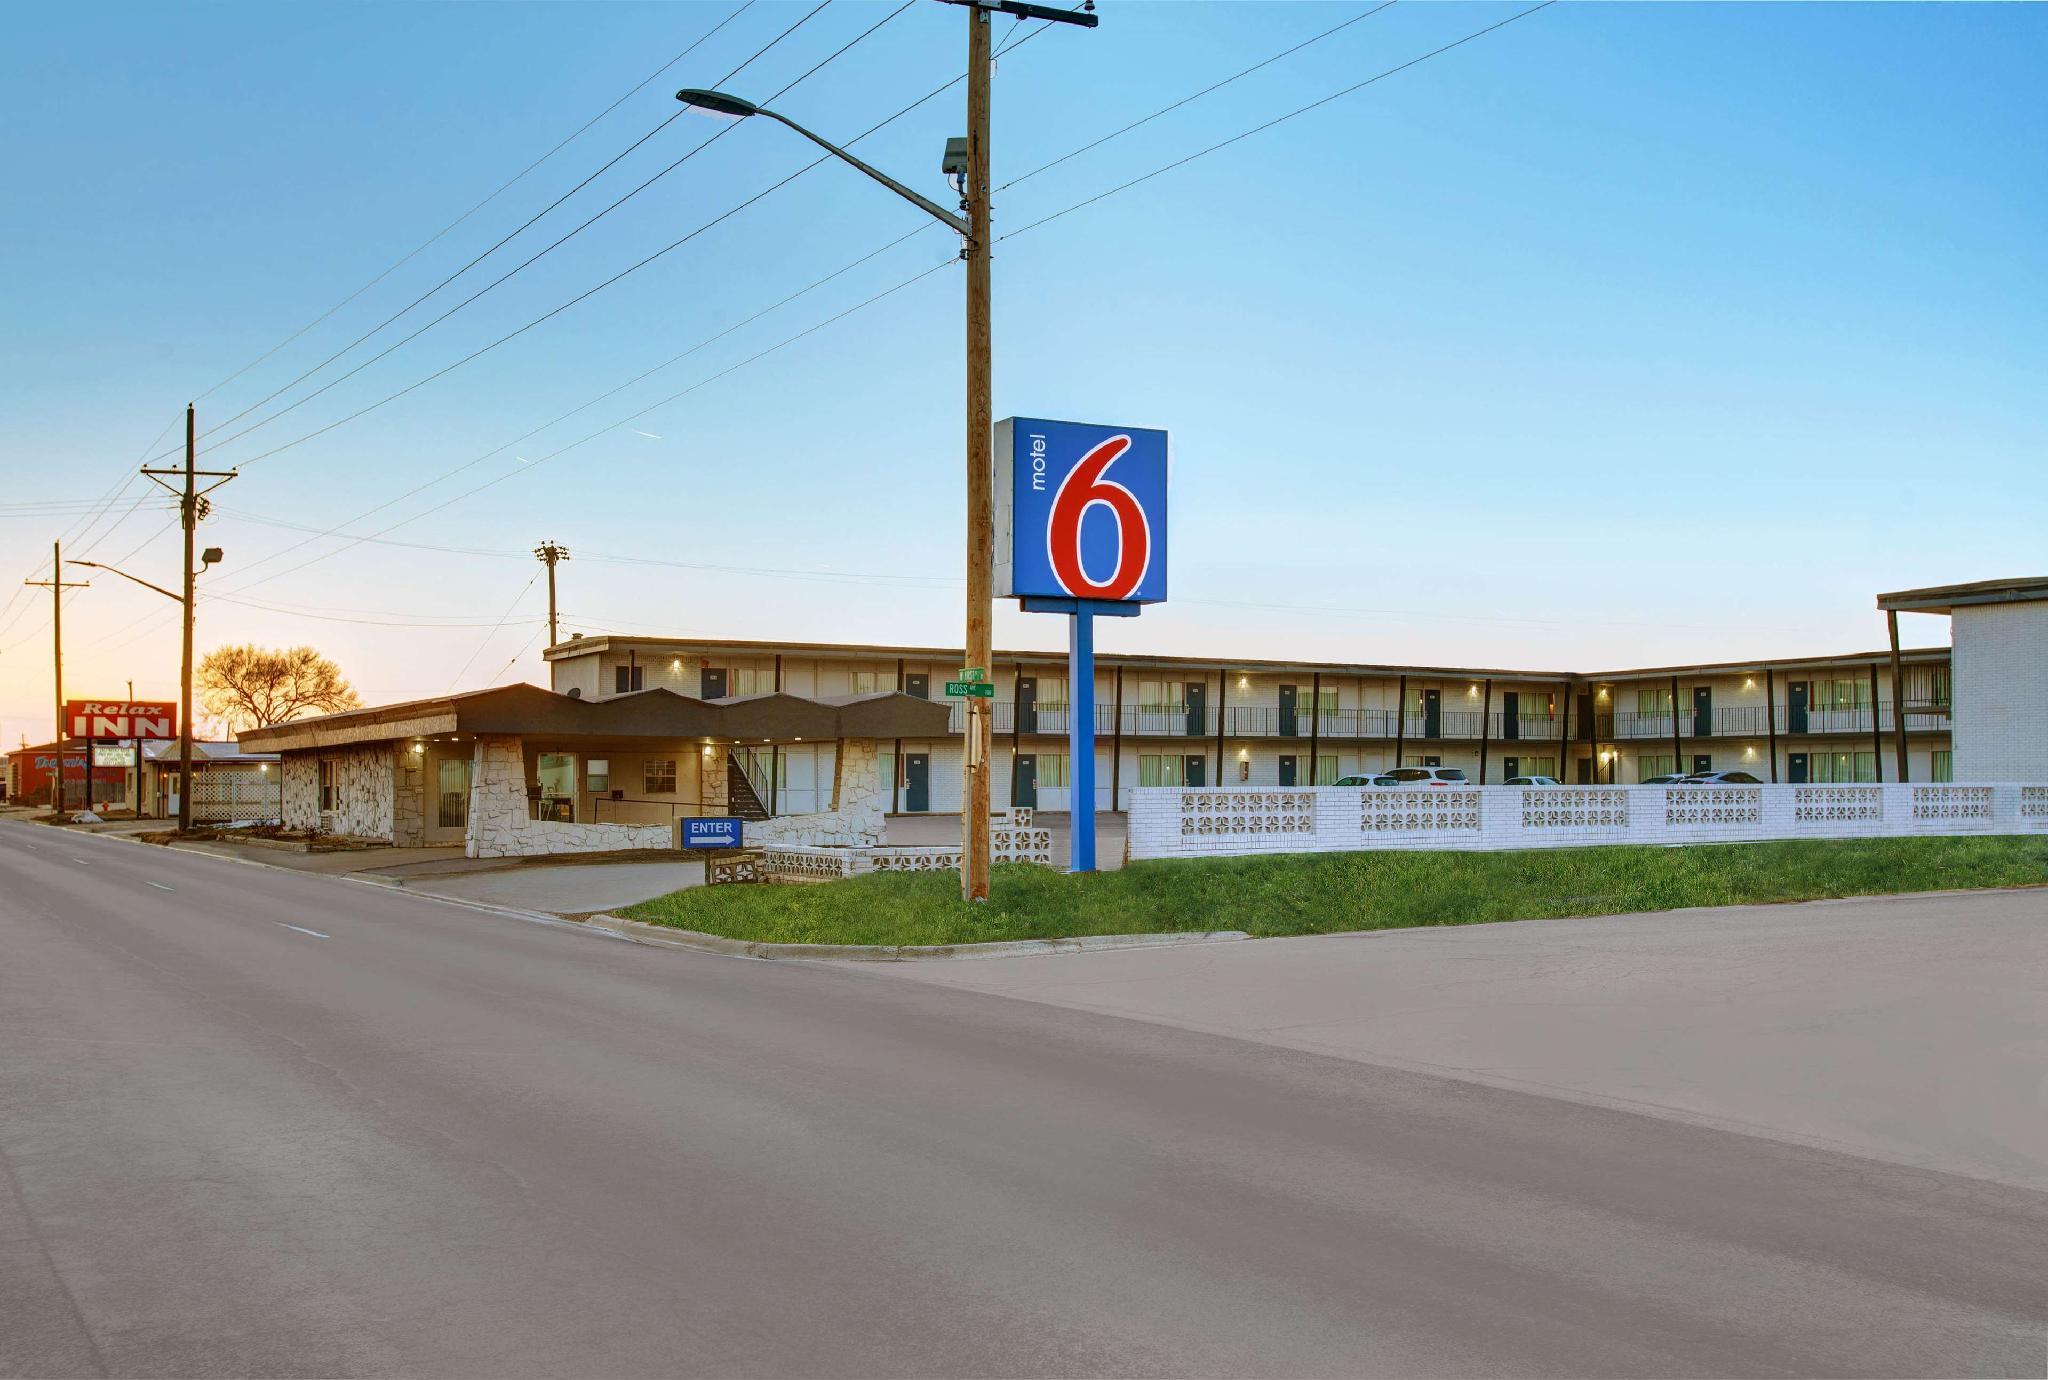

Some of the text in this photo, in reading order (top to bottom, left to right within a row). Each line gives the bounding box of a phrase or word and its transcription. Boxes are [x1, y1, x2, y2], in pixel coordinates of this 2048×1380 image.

[1029, 434, 1046, 491] motel
[1047, 433, 1151, 600] 6
[949, 684, 968, 694] ROSS
[82, 702, 163, 715] Relax
[74, 716, 170, 737] INN
[691, 822, 732, 833] ENTER
